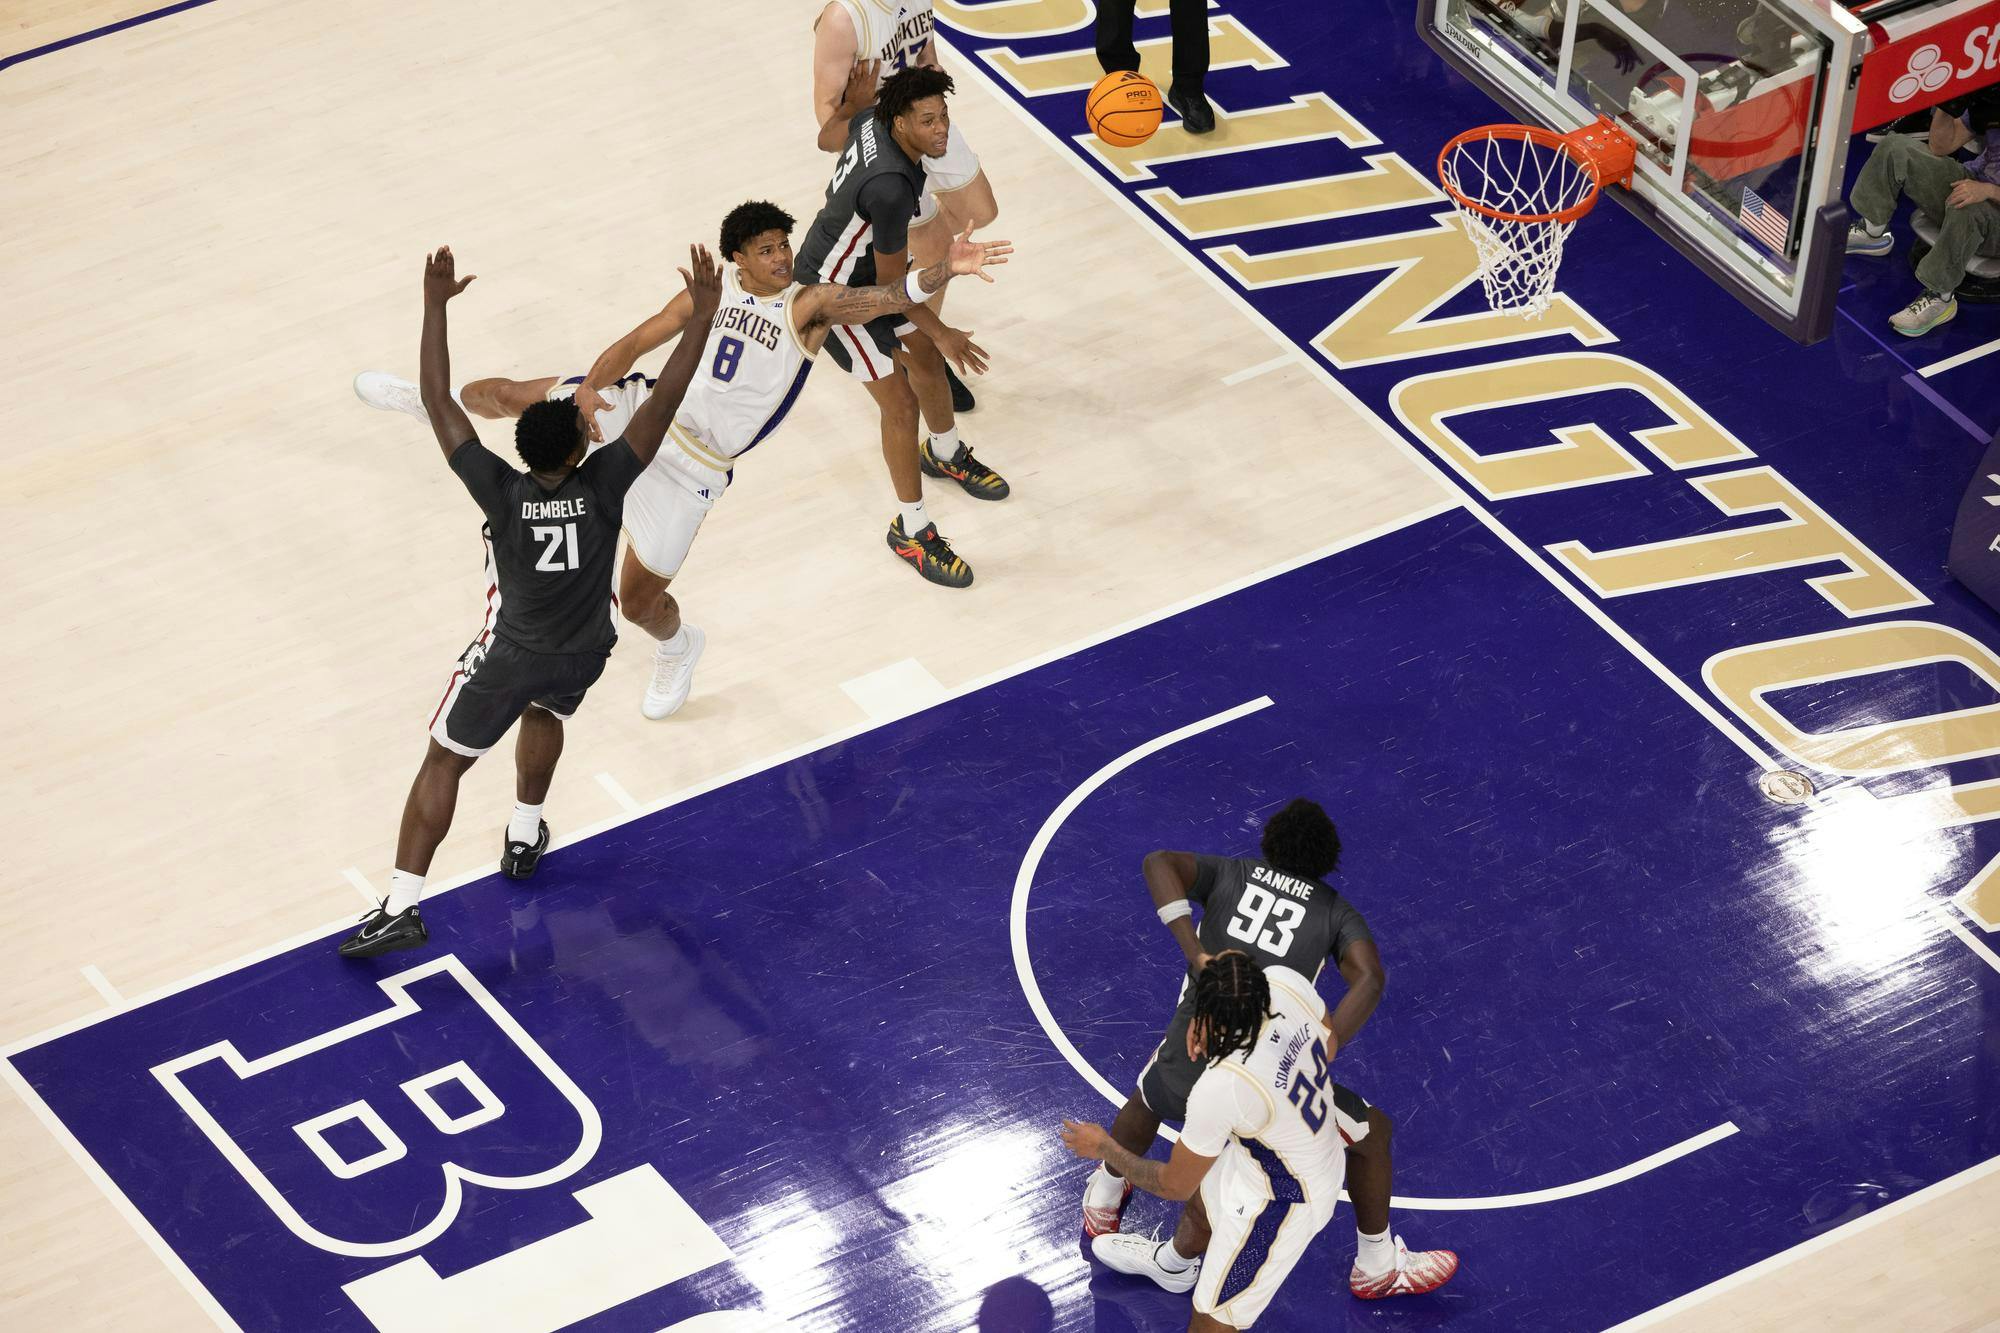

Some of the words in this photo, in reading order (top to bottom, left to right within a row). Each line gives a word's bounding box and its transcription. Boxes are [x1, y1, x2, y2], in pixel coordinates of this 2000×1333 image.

[1444, 22, 1481, 60] SPALDING
[1956, 21, 2000, 80] St
[832, 140, 859, 194] 3
[860, 117, 878, 168] HARRELL
[712, 335, 745, 383] 8
[521, 497, 586, 520] DEMBELE
[530, 522, 580, 572] 21
[1251, 866, 1314, 901] SANKHE
[1226, 882, 1306, 958] 93
[1269, 1030, 1281, 1044] W
[1274, 1022, 1312, 1090] SOMMERVILLE
[1287, 1036, 1329, 1135] 24
